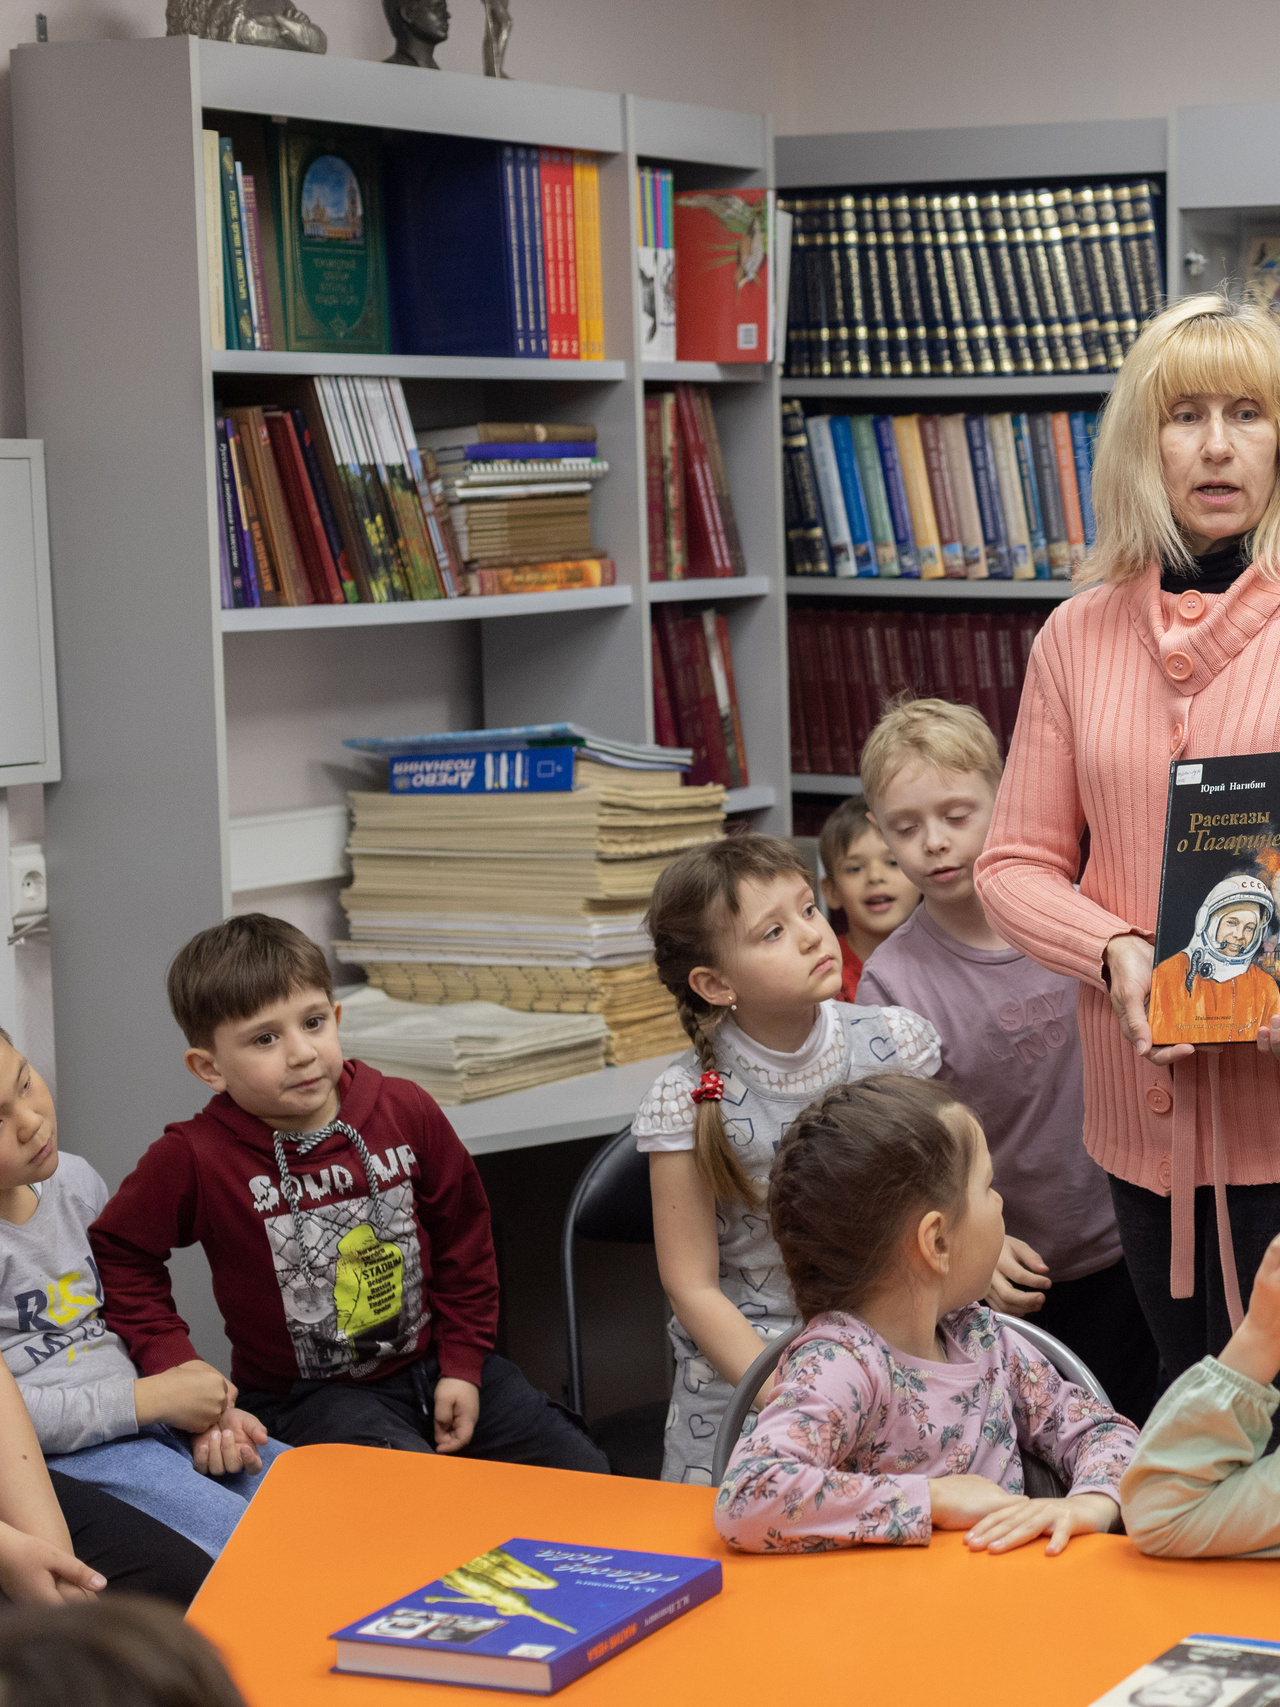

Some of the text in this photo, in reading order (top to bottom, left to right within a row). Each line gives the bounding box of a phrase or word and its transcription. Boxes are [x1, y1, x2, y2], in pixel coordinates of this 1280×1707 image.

[1200, 780, 1266, 794] Юрий Нагибин
[1188, 811, 1270, 833] Рассказы
[1176, 838, 1188, 853] о
[998, 990, 1065, 1031] SAY
